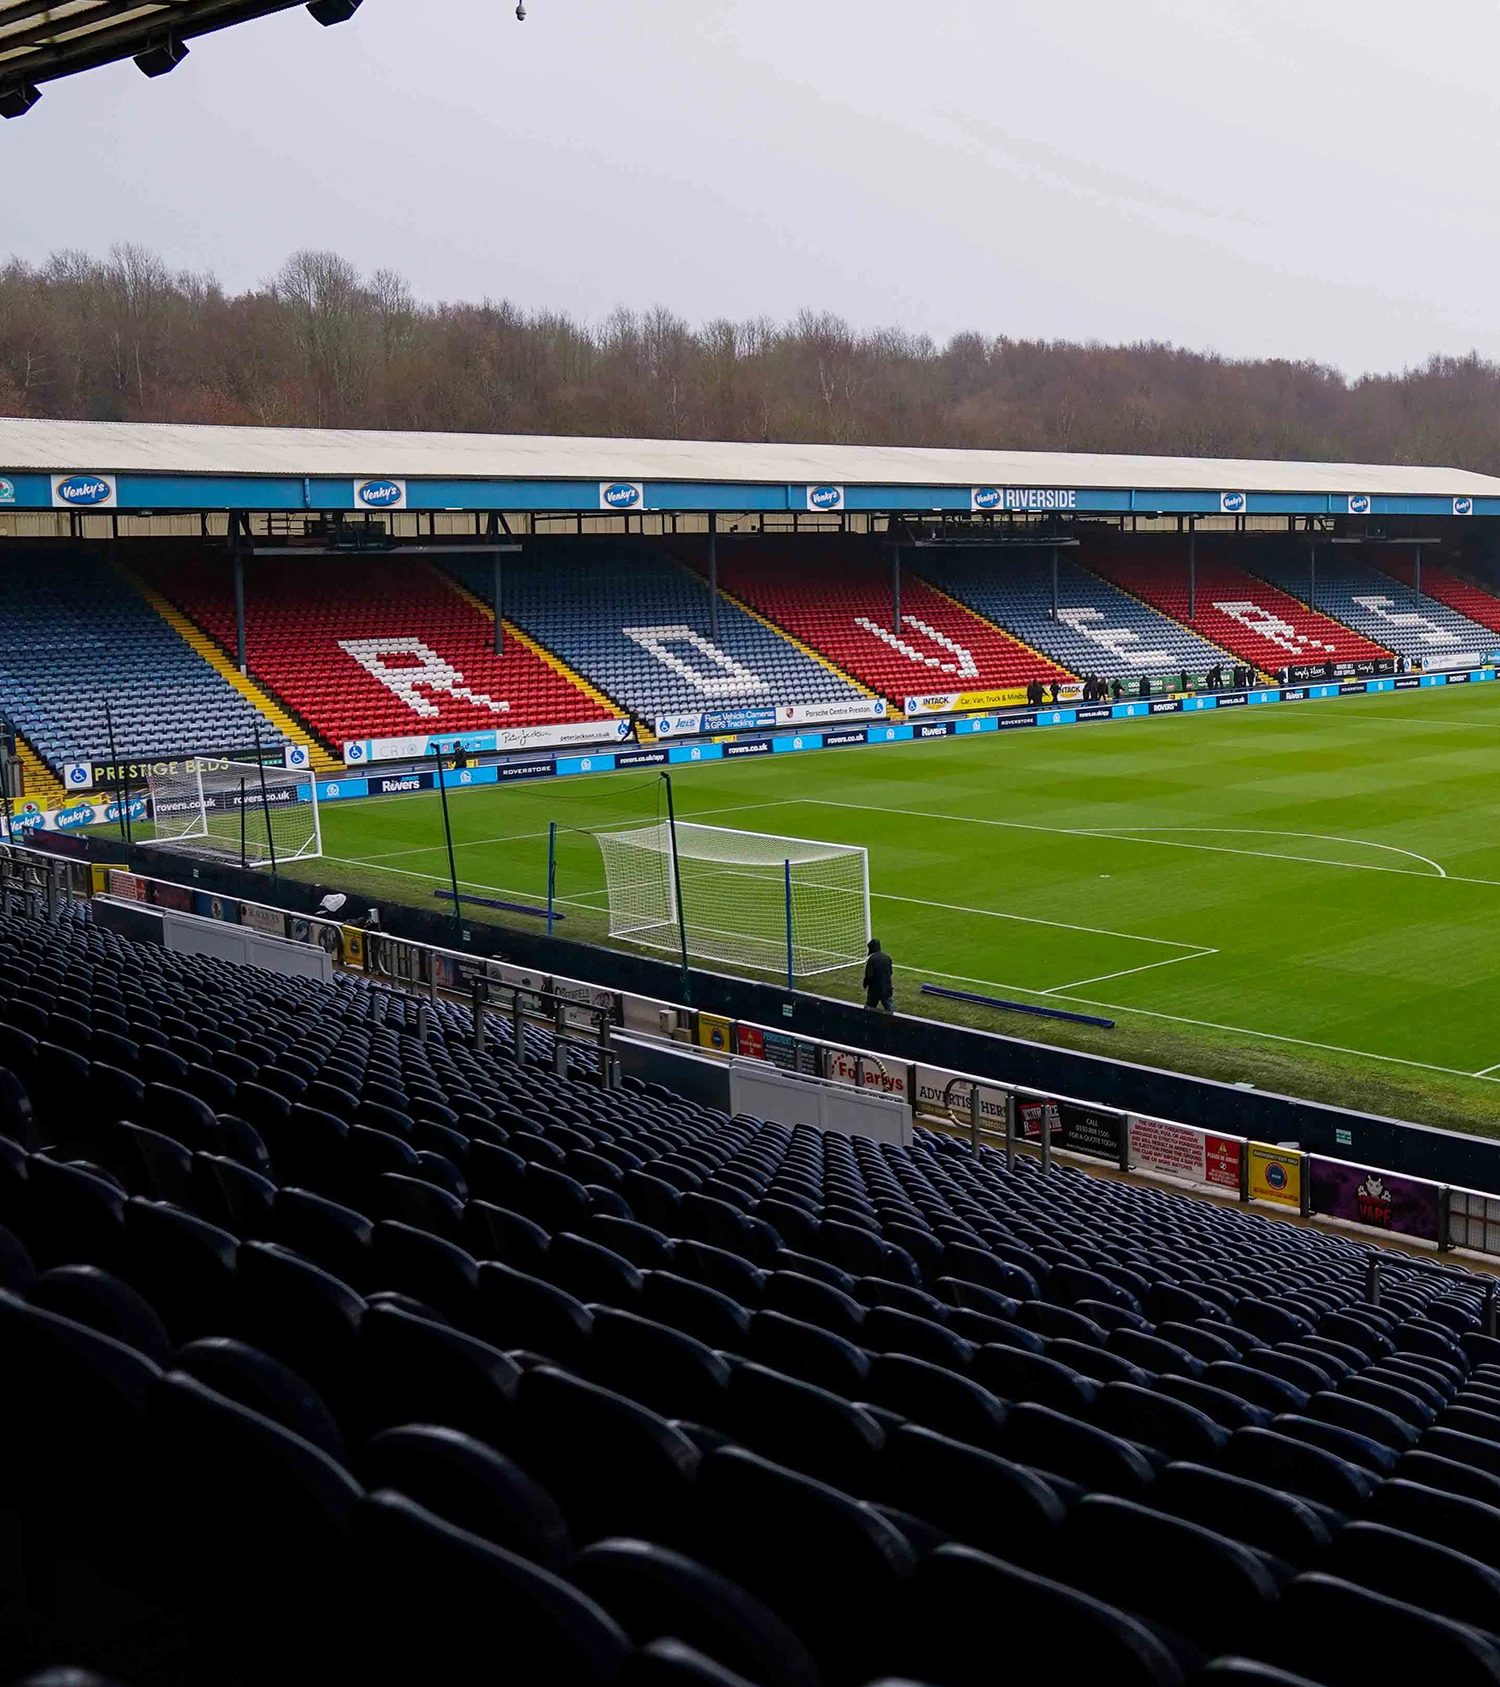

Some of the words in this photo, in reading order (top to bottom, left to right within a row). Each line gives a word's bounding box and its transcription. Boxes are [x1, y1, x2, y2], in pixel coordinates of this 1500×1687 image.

[63, 482, 106, 500] Venky's
[363, 486, 398, 501] Venky's
[607, 488, 636, 503] Venky's
[813, 489, 838, 503] Venky's
[976, 491, 998, 505] Venky's
[1006, 490, 1076, 508] RIVERSIDE
[922, 696, 949, 705] INTACK
[961, 698, 971, 706] Car,
[986, 695, 1001, 703] Truck
[1007, 693, 1028, 701] Minibu
[806, 710, 829, 718] Porsche
[847, 706, 870, 715] Preston
[1001, 718, 1034, 726] ROVERSTORE
[560, 733, 610, 742] peterjackson.co.uk
[827, 733, 865, 744] rovers.co.uk
[728, 742, 769, 754] rovers.co.uk
[619, 752, 664, 764] rovers.co.uk/app
[95, 760, 178, 782] PRESTIGE
[185, 756, 230, 774] BEDS
[503, 766, 552, 775] ROVERSTORE
[57, 808, 92, 827] Venky's
[1086, 1118, 1098, 1127] CALL
[1075, 1125, 1088, 1133] 0330
[1088, 1127, 1098, 1135] 808
[1098, 1129, 1110, 1138] 1500
[1069, 1131, 1079, 1139] FOR
[1084, 1135, 1100, 1145] QUOTE
[1100, 1138, 1117, 1148] TODAY
